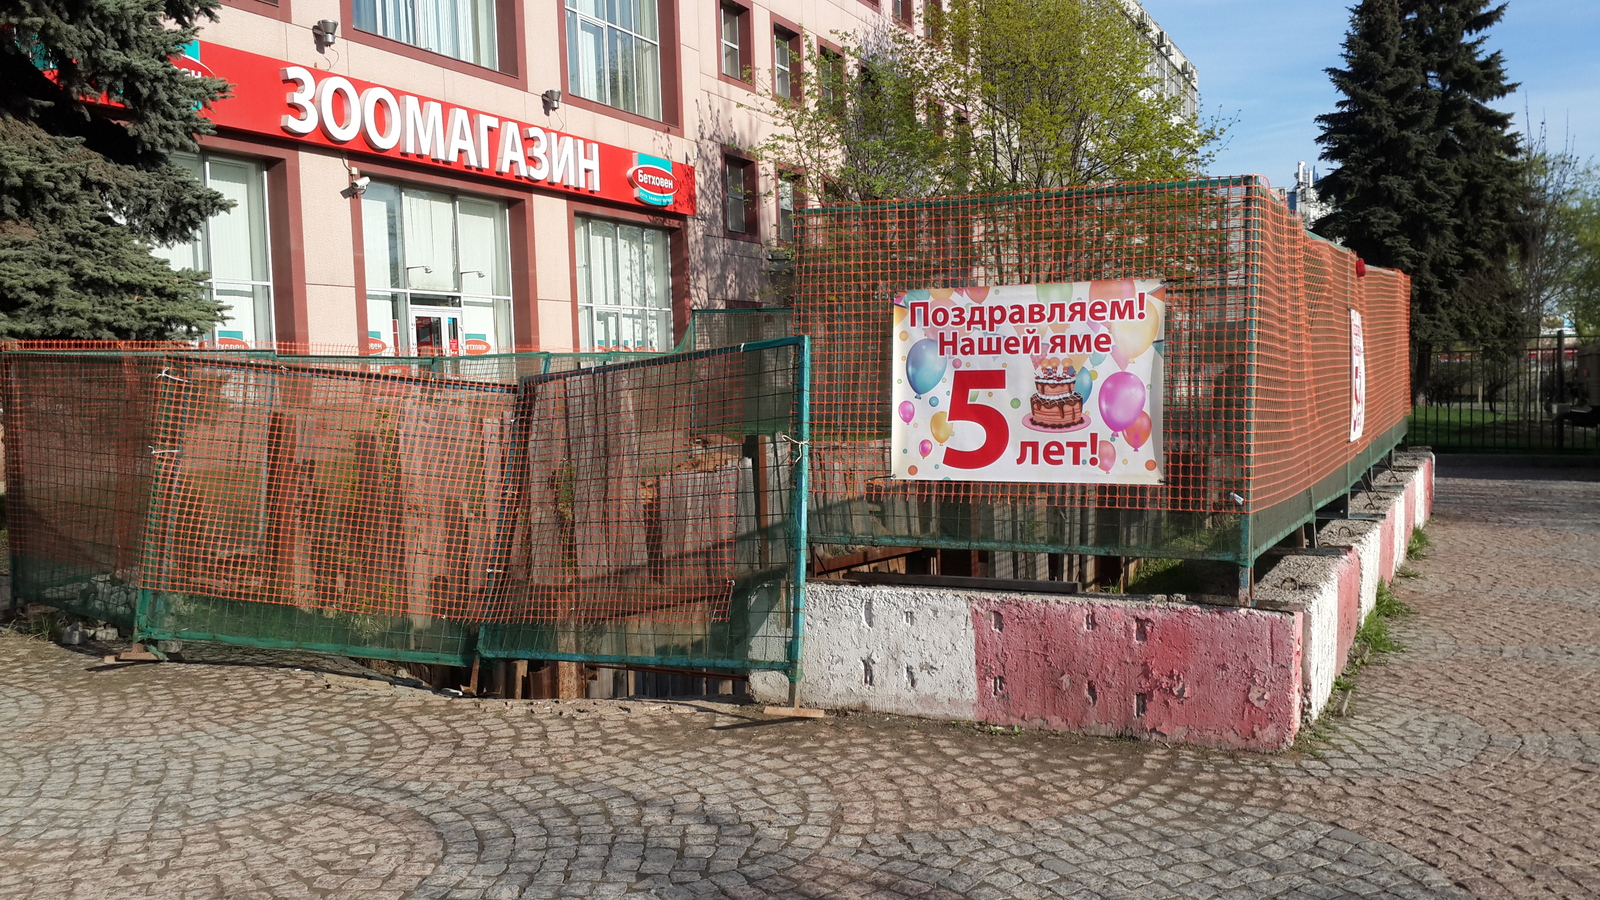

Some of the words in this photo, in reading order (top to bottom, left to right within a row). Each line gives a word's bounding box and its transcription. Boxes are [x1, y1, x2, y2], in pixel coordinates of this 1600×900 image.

[280, 66, 600, 192] ЗООМАГАЗИН
[638, 169, 674, 189] Бетховен
[910, 292, 1147, 332] Поздравляем!
[938, 328, 1041, 356] Нашей
[1049, 332, 1112, 354] яме
[942, 369, 1009, 470] 5
[1015, 432, 1099, 466] лет!
